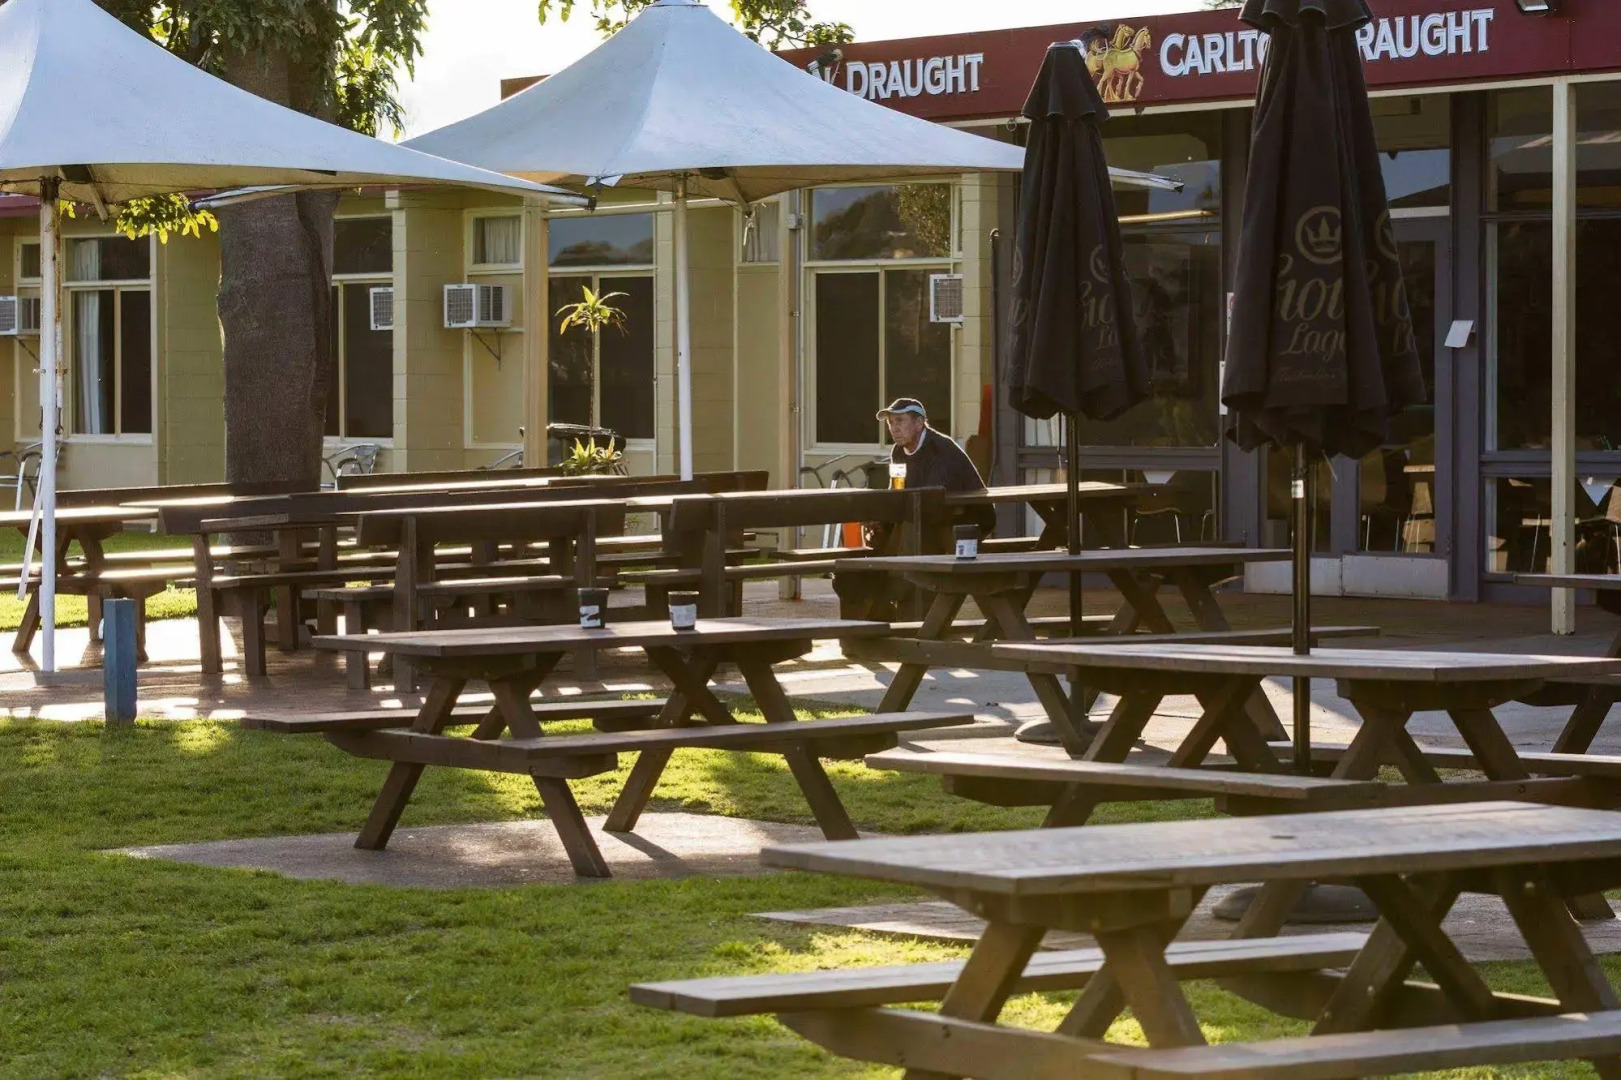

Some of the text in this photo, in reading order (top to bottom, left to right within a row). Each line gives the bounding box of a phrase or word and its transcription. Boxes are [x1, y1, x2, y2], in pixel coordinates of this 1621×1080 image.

[1160, 8, 1495, 77] CARLT RAUGHT
[846, 52, 984, 100] DRAUGHT
